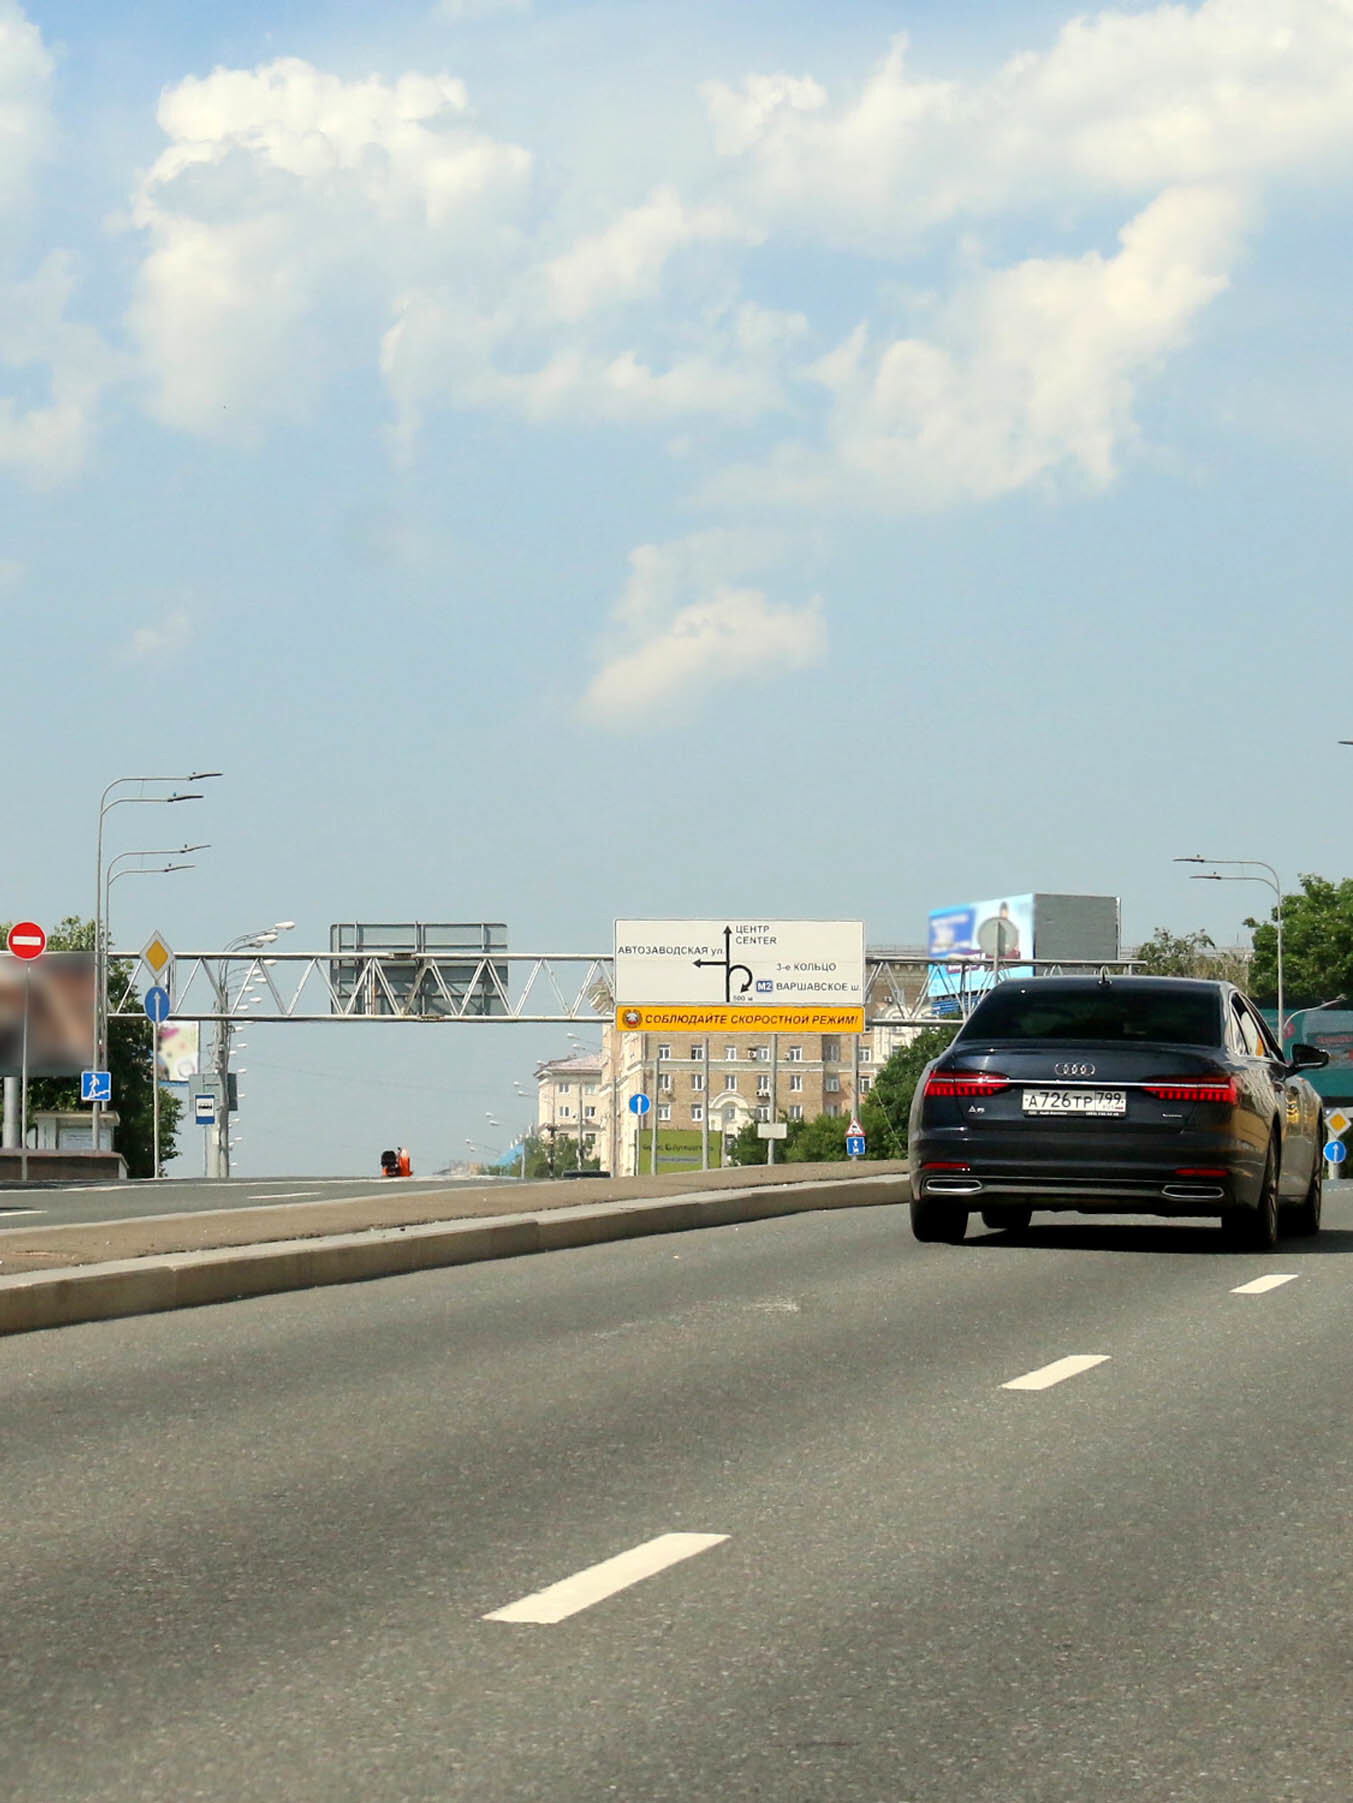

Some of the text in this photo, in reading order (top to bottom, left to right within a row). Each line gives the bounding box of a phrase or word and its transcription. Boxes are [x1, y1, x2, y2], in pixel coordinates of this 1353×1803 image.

[735, 925, 770, 934] ЦЕНТР
[735, 936, 777, 945] CENTER
[617, 946, 708, 955] АВТОЗАВОДСКАЯ
[776, 963, 837, 972] 3-е КОЛЬЦО
[776, 983, 848, 992] ВАРШАВСКОЕ
[645, 1014, 727, 1025] СОБЛЮДАЙТЕ
[812, 1015, 858, 1025] РЕЖИМ!
